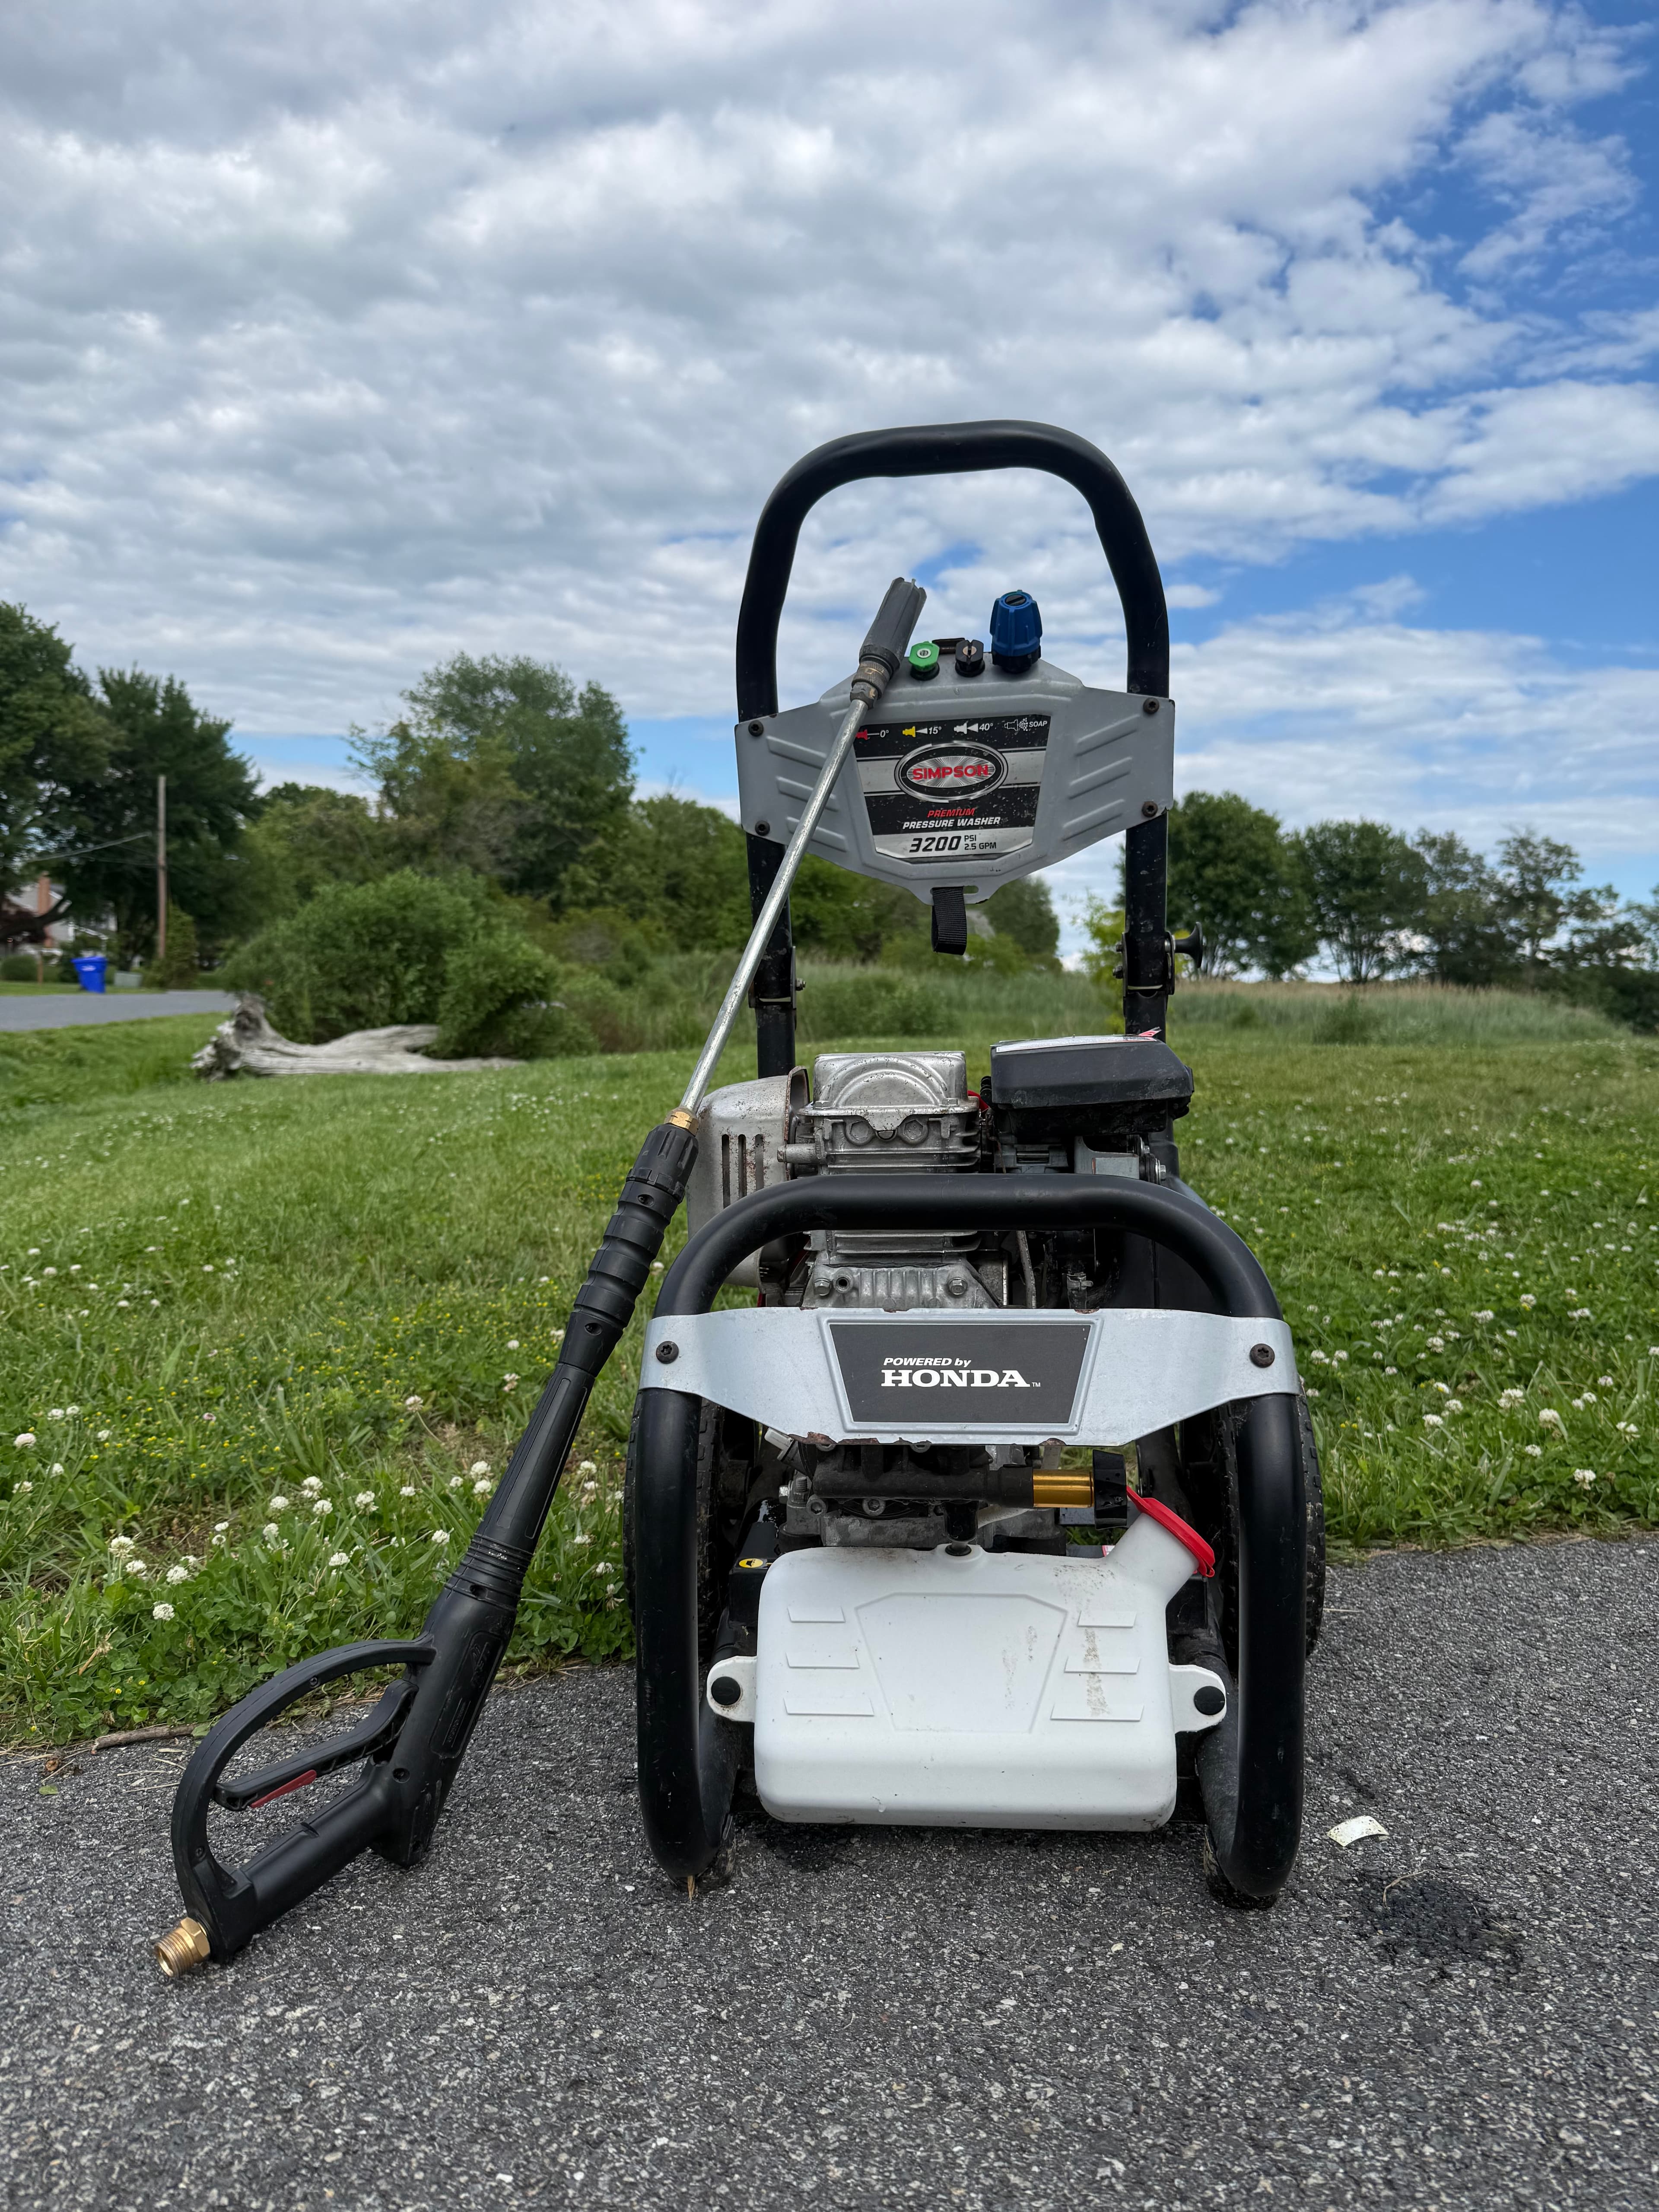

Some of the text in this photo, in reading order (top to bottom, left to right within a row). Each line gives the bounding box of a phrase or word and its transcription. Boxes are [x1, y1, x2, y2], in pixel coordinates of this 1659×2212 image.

[929, 726, 942, 734] 15°
[979, 723, 993, 731] 40°
[912, 764, 988, 780] SIMPSON
[927, 808, 975, 817] PREMIUM
[903, 817, 1001, 830] PRESSURE WASHER
[909, 836, 962, 853] 3200
[883, 1357, 972, 1367] POWERED by
[880, 1369, 1031, 1387] HONDA
